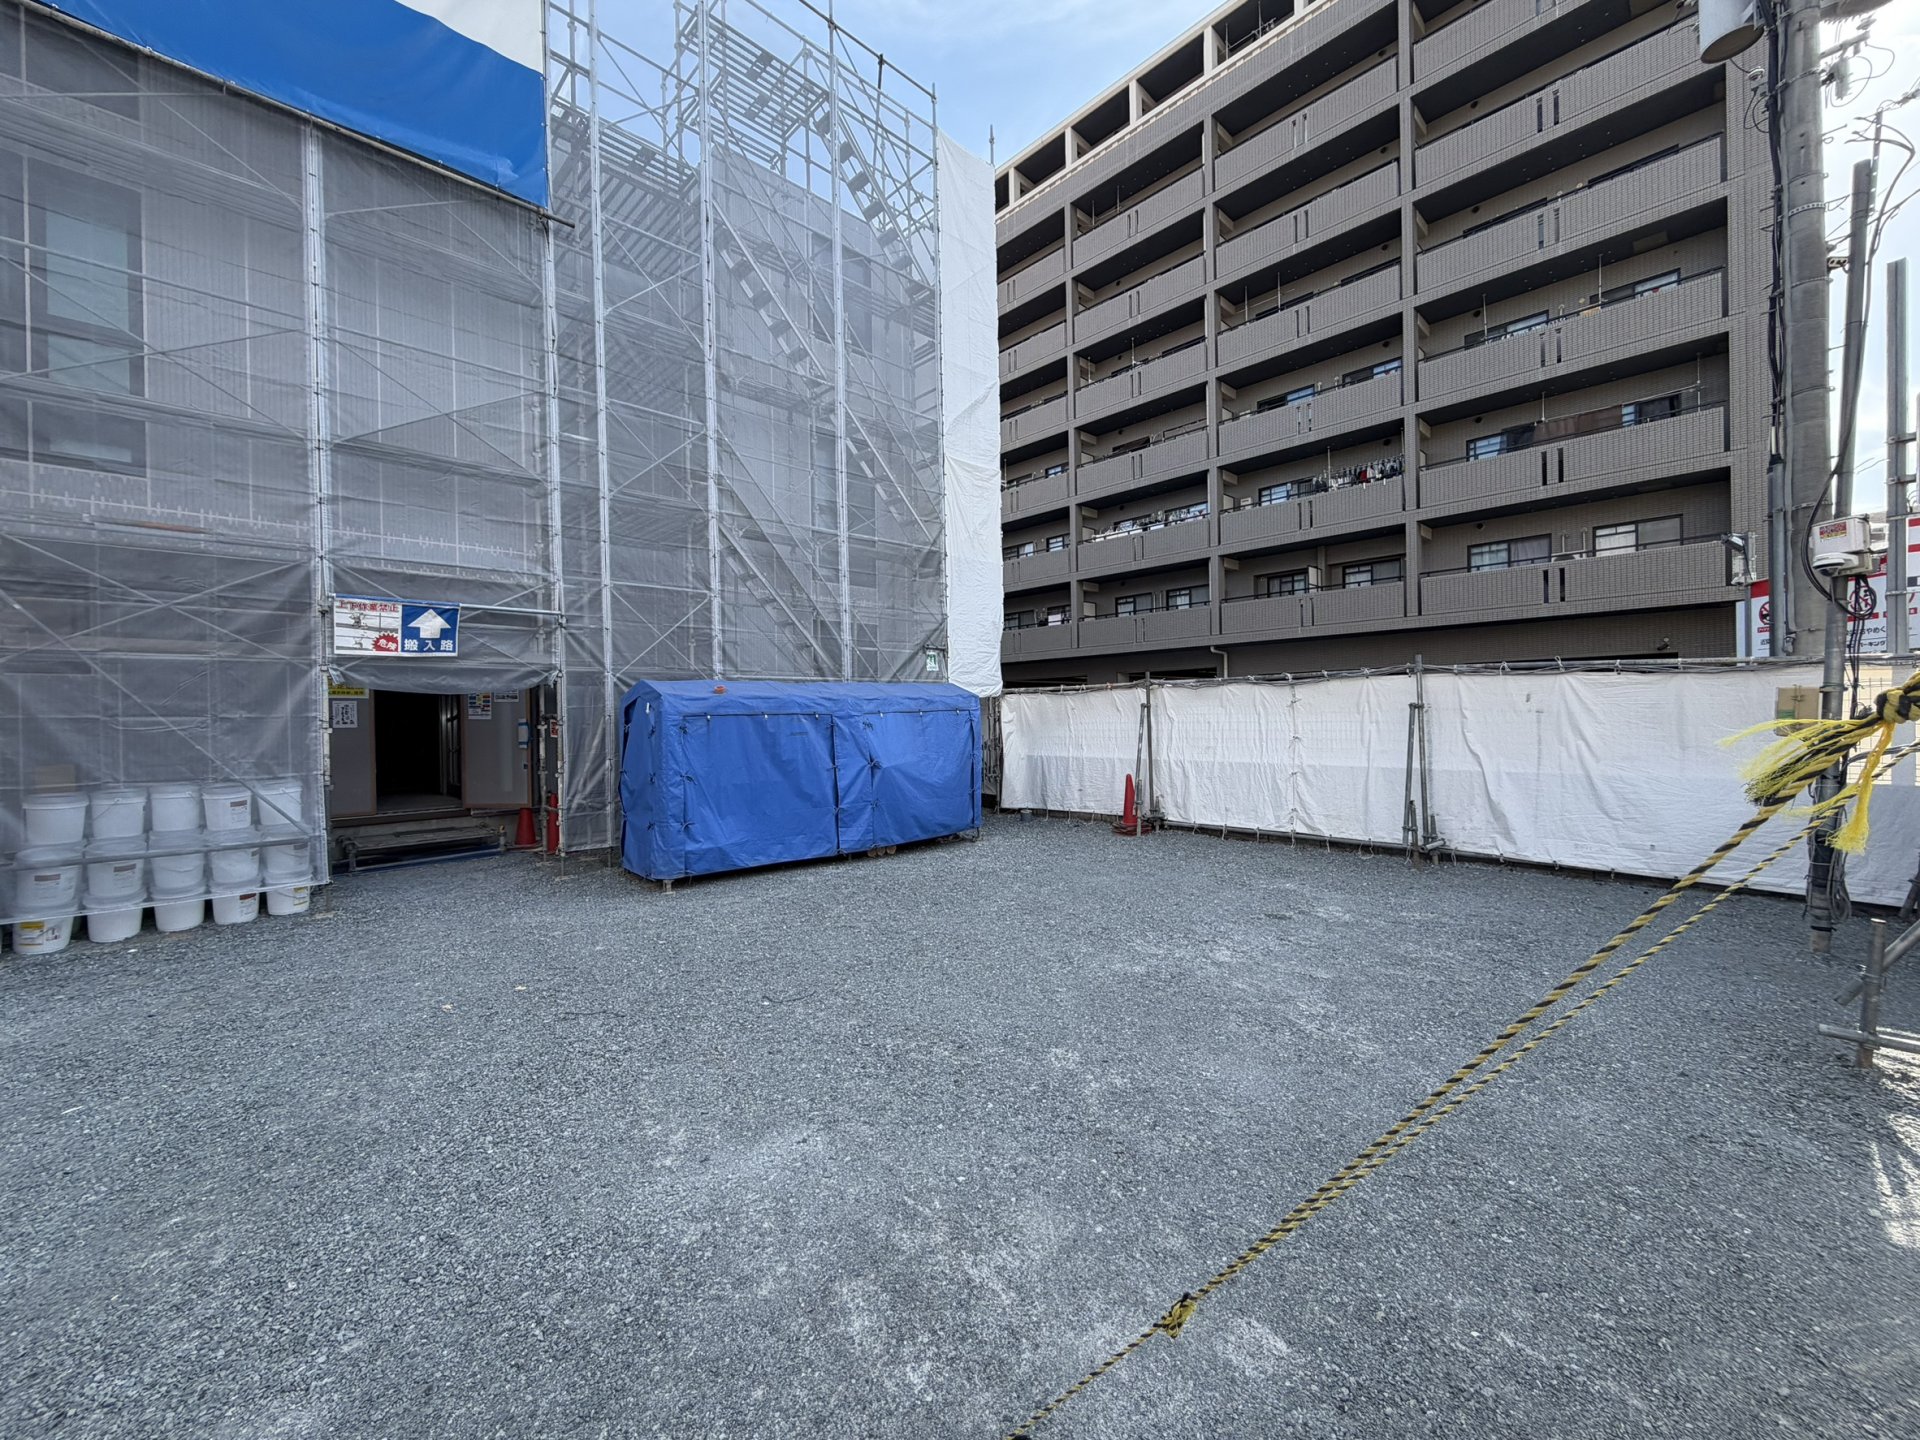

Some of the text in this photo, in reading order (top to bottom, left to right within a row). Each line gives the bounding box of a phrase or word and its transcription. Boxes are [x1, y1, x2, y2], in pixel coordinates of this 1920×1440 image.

[337, 600, 399, 612] 上下作業禁止
[377, 638, 397, 651] 危険
[404, 638, 454, 651] 搬入路
